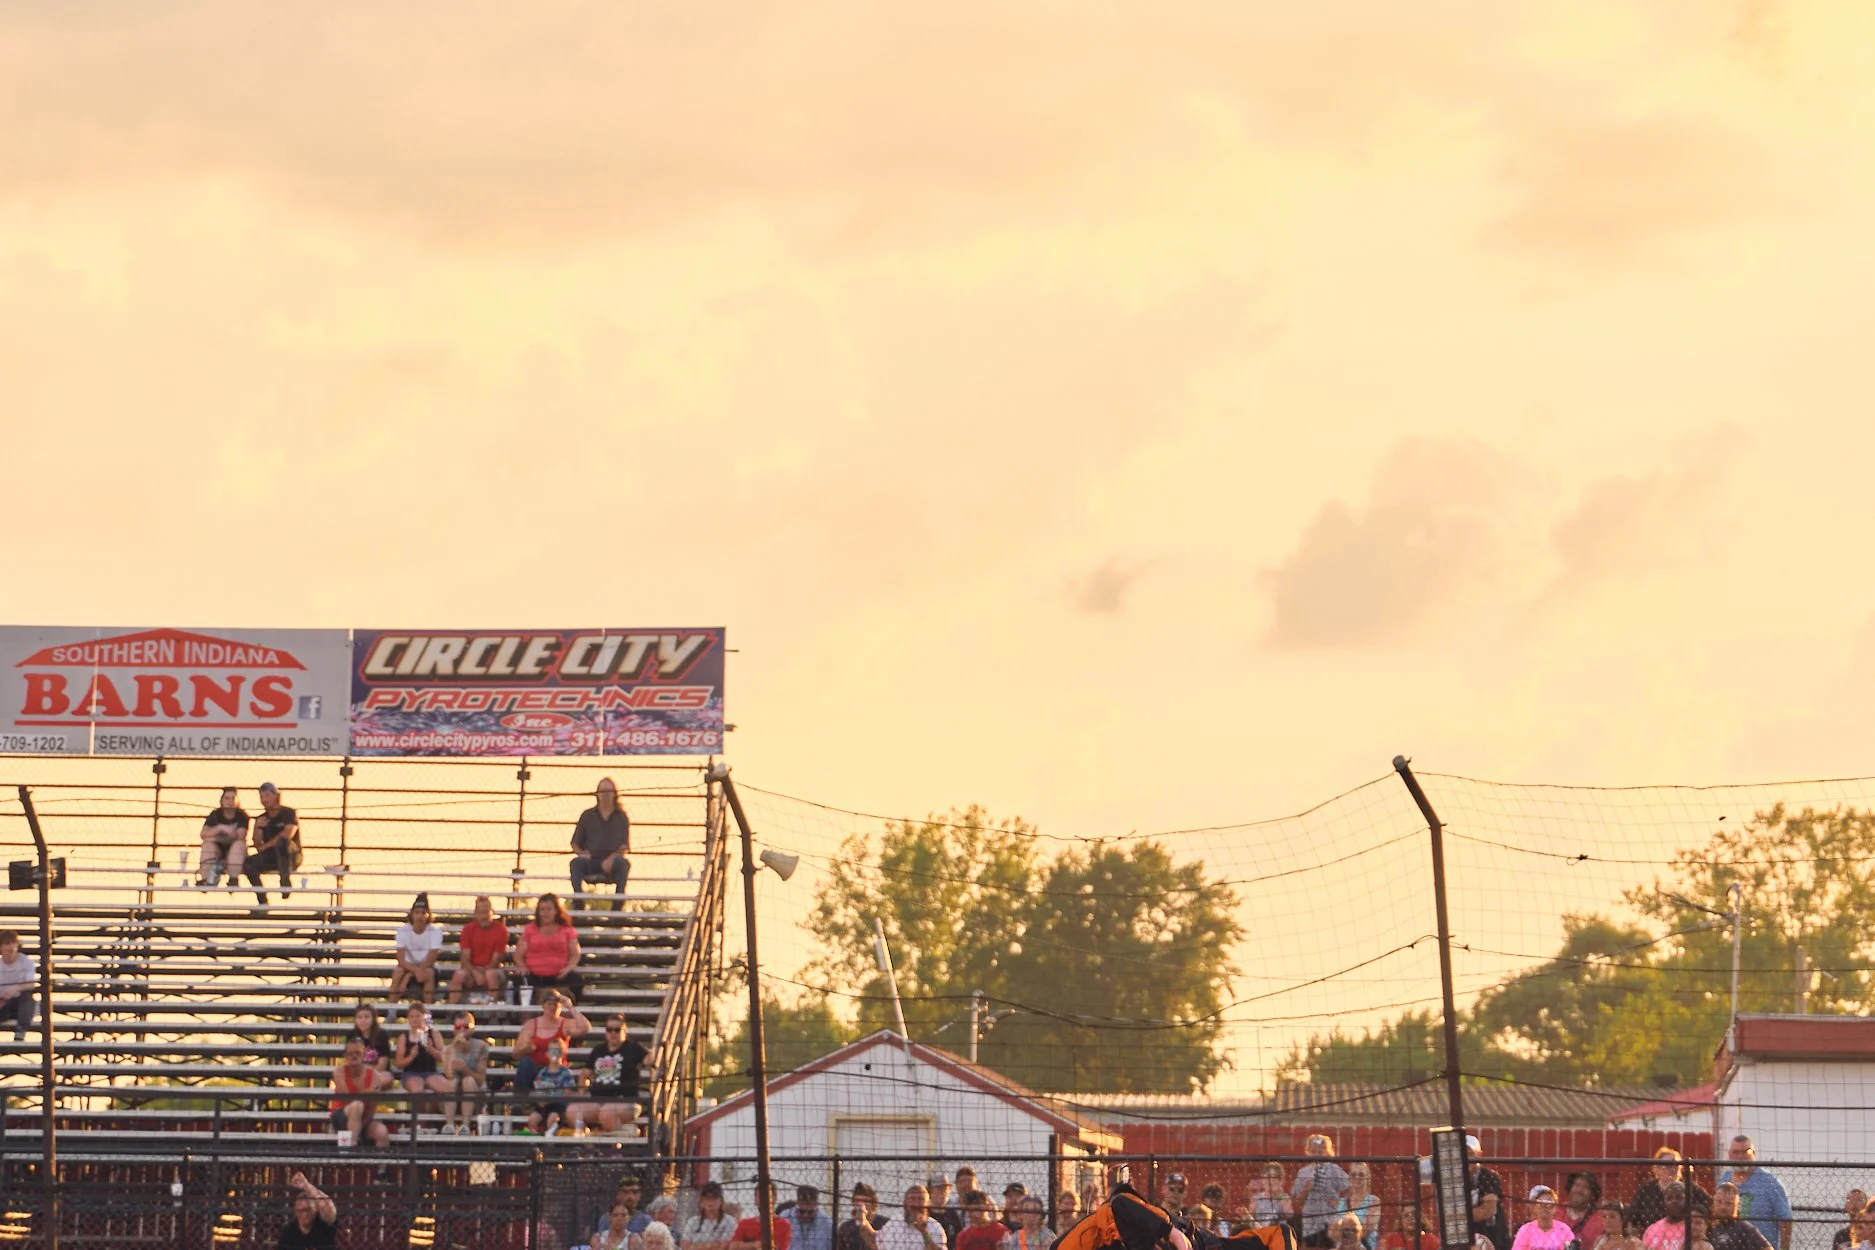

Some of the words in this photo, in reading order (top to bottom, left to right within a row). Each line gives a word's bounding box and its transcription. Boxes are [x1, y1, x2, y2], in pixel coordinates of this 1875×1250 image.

[52, 640, 175, 664] SOUTHERN
[183, 640, 280, 665] INDIANA
[363, 636, 558, 678] CIRCLE
[559, 635, 708, 676] CITY
[20, 673, 294, 718] BARNS
[361, 685, 714, 712] PYROTECHNICS
[168, 737, 194, 751] ALL
[200, 737, 220, 751] OF
[355, 733, 554, 751] www.circlecitypyros.com
[571, 731, 718, 748] 317.486.1676
